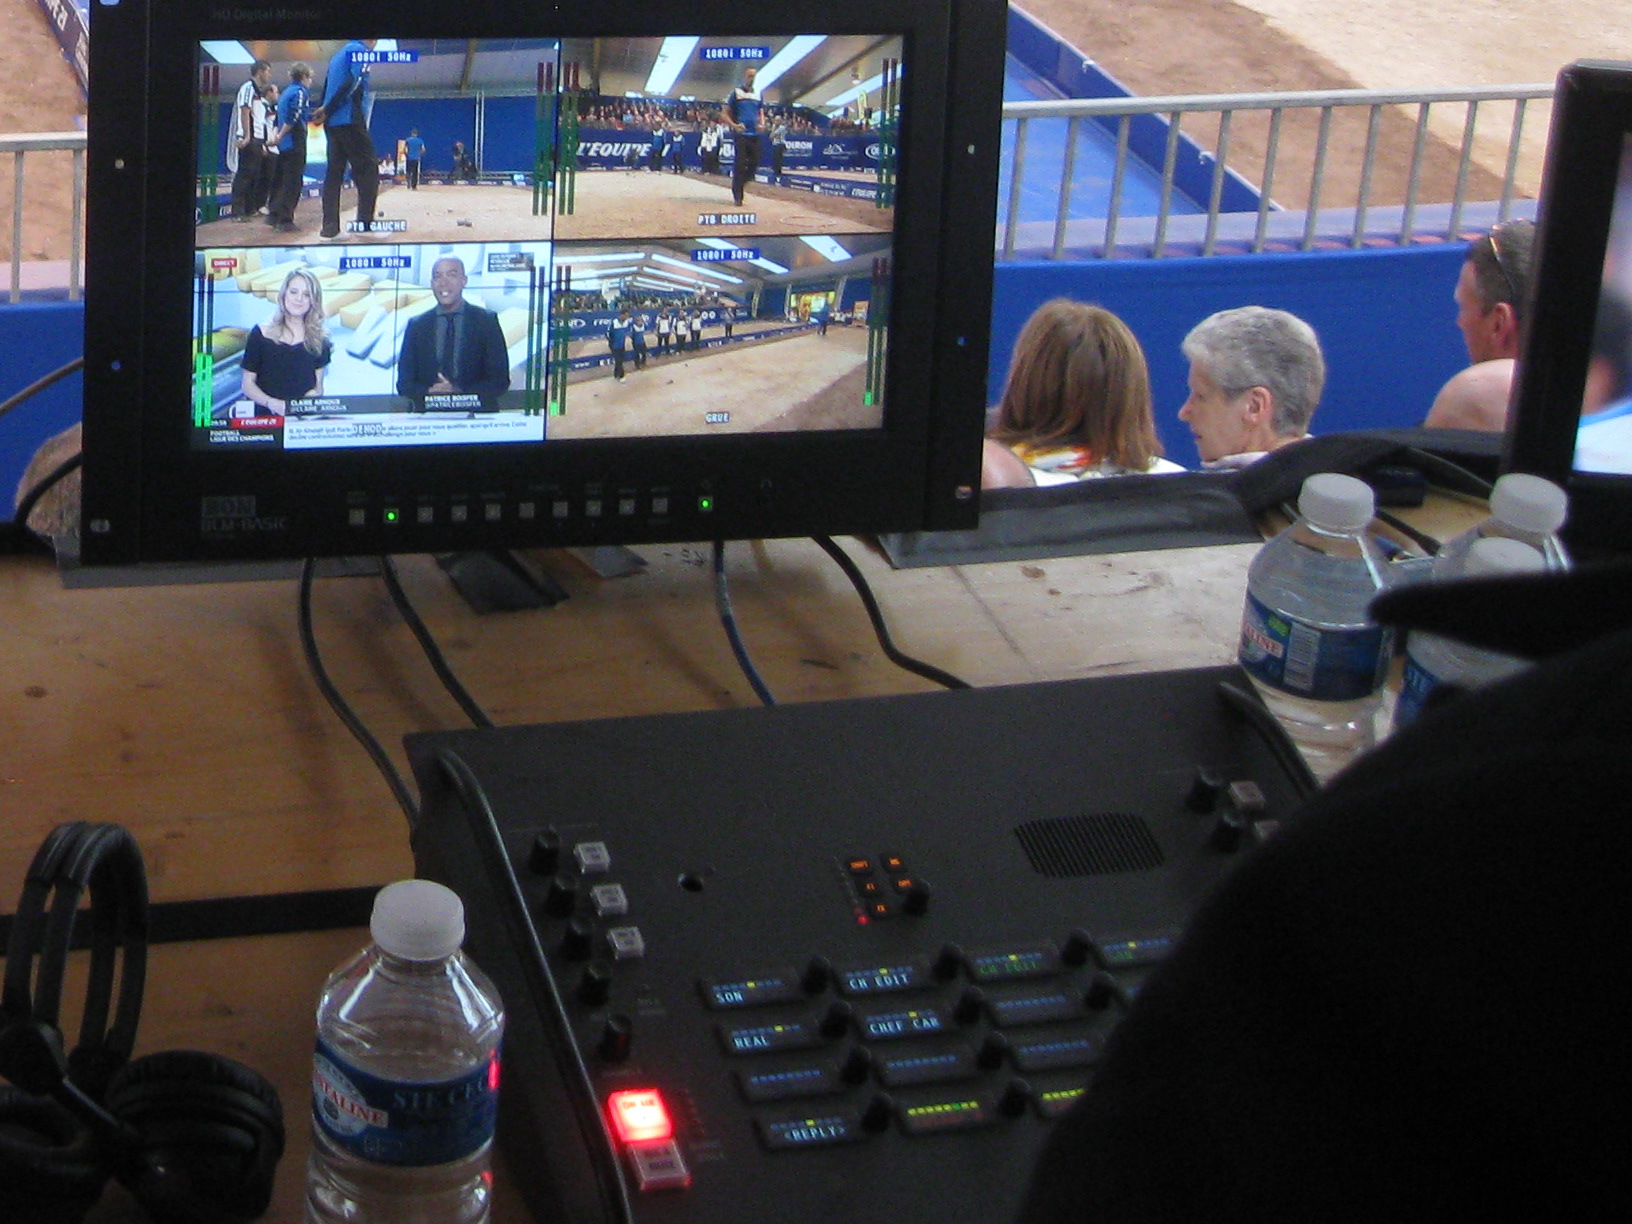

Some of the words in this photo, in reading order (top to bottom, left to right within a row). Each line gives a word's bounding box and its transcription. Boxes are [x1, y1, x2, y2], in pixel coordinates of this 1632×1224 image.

[369, 220, 406, 232] GAUCHE
[874, 973, 910, 987] EDIT
[716, 990, 744, 1004] SON
[733, 1035, 770, 1050] REAL
